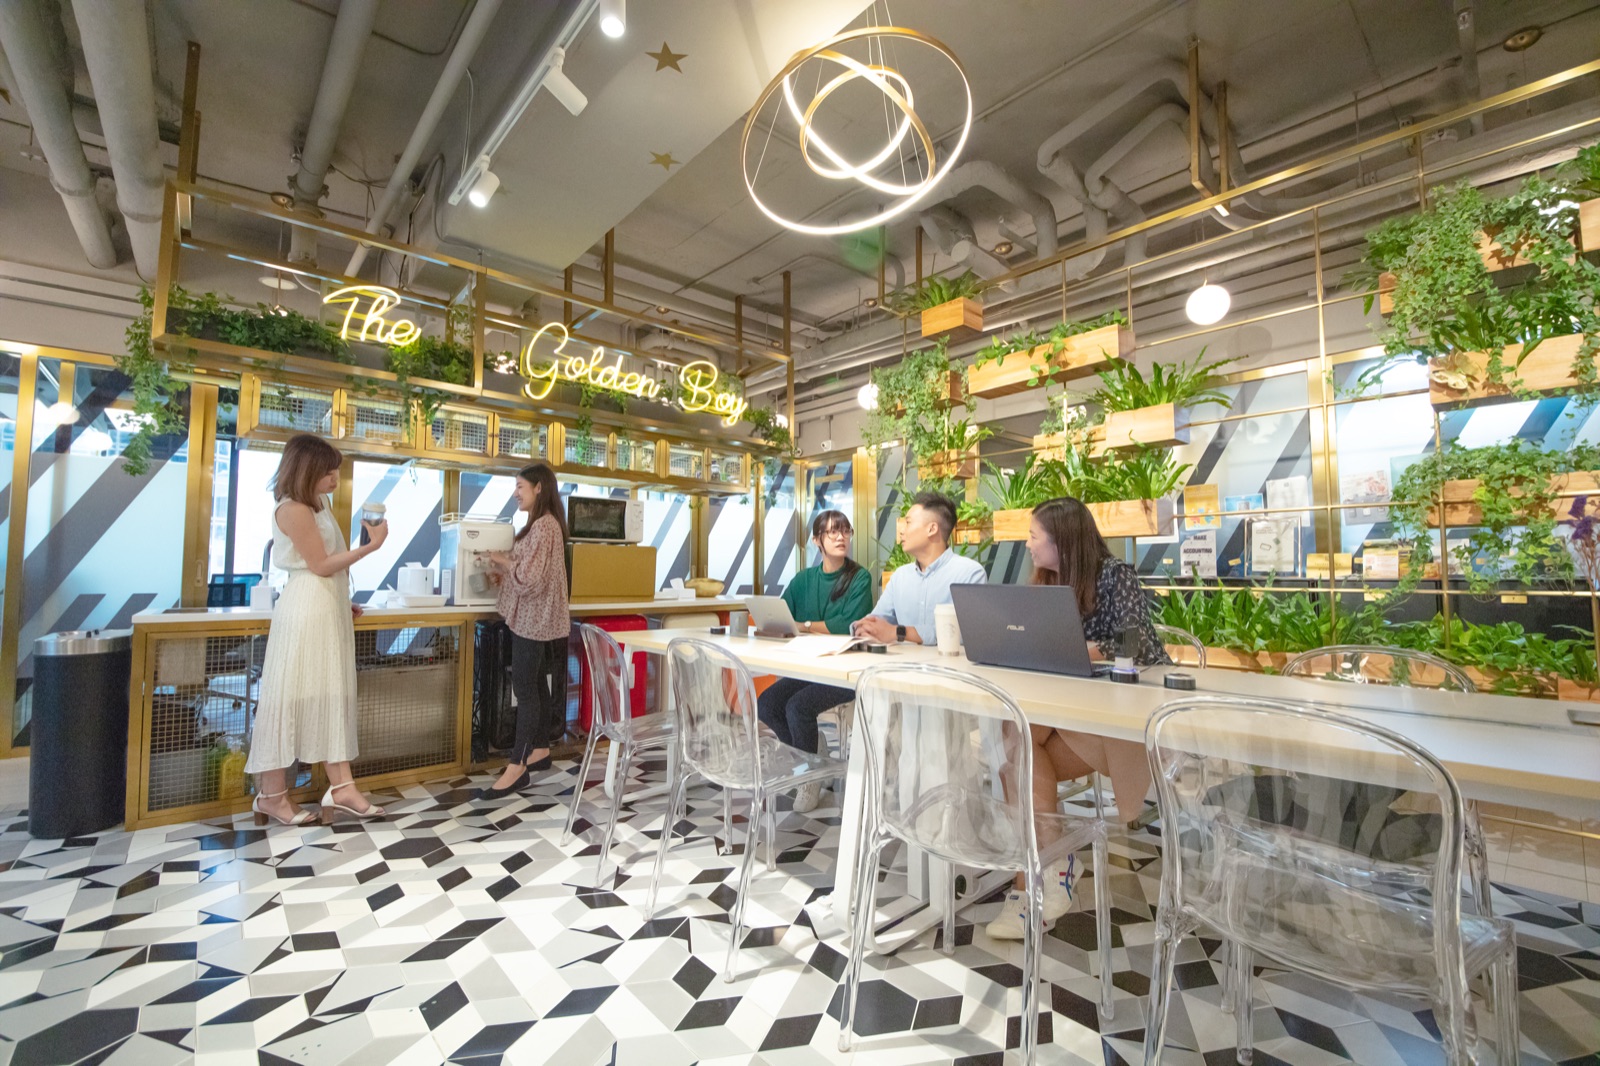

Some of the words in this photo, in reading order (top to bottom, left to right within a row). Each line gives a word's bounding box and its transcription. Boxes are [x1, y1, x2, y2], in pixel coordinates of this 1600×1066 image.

[323, 285, 422, 346] The
[525, 321, 660, 400] Golden
[678, 360, 748, 428] Boy
